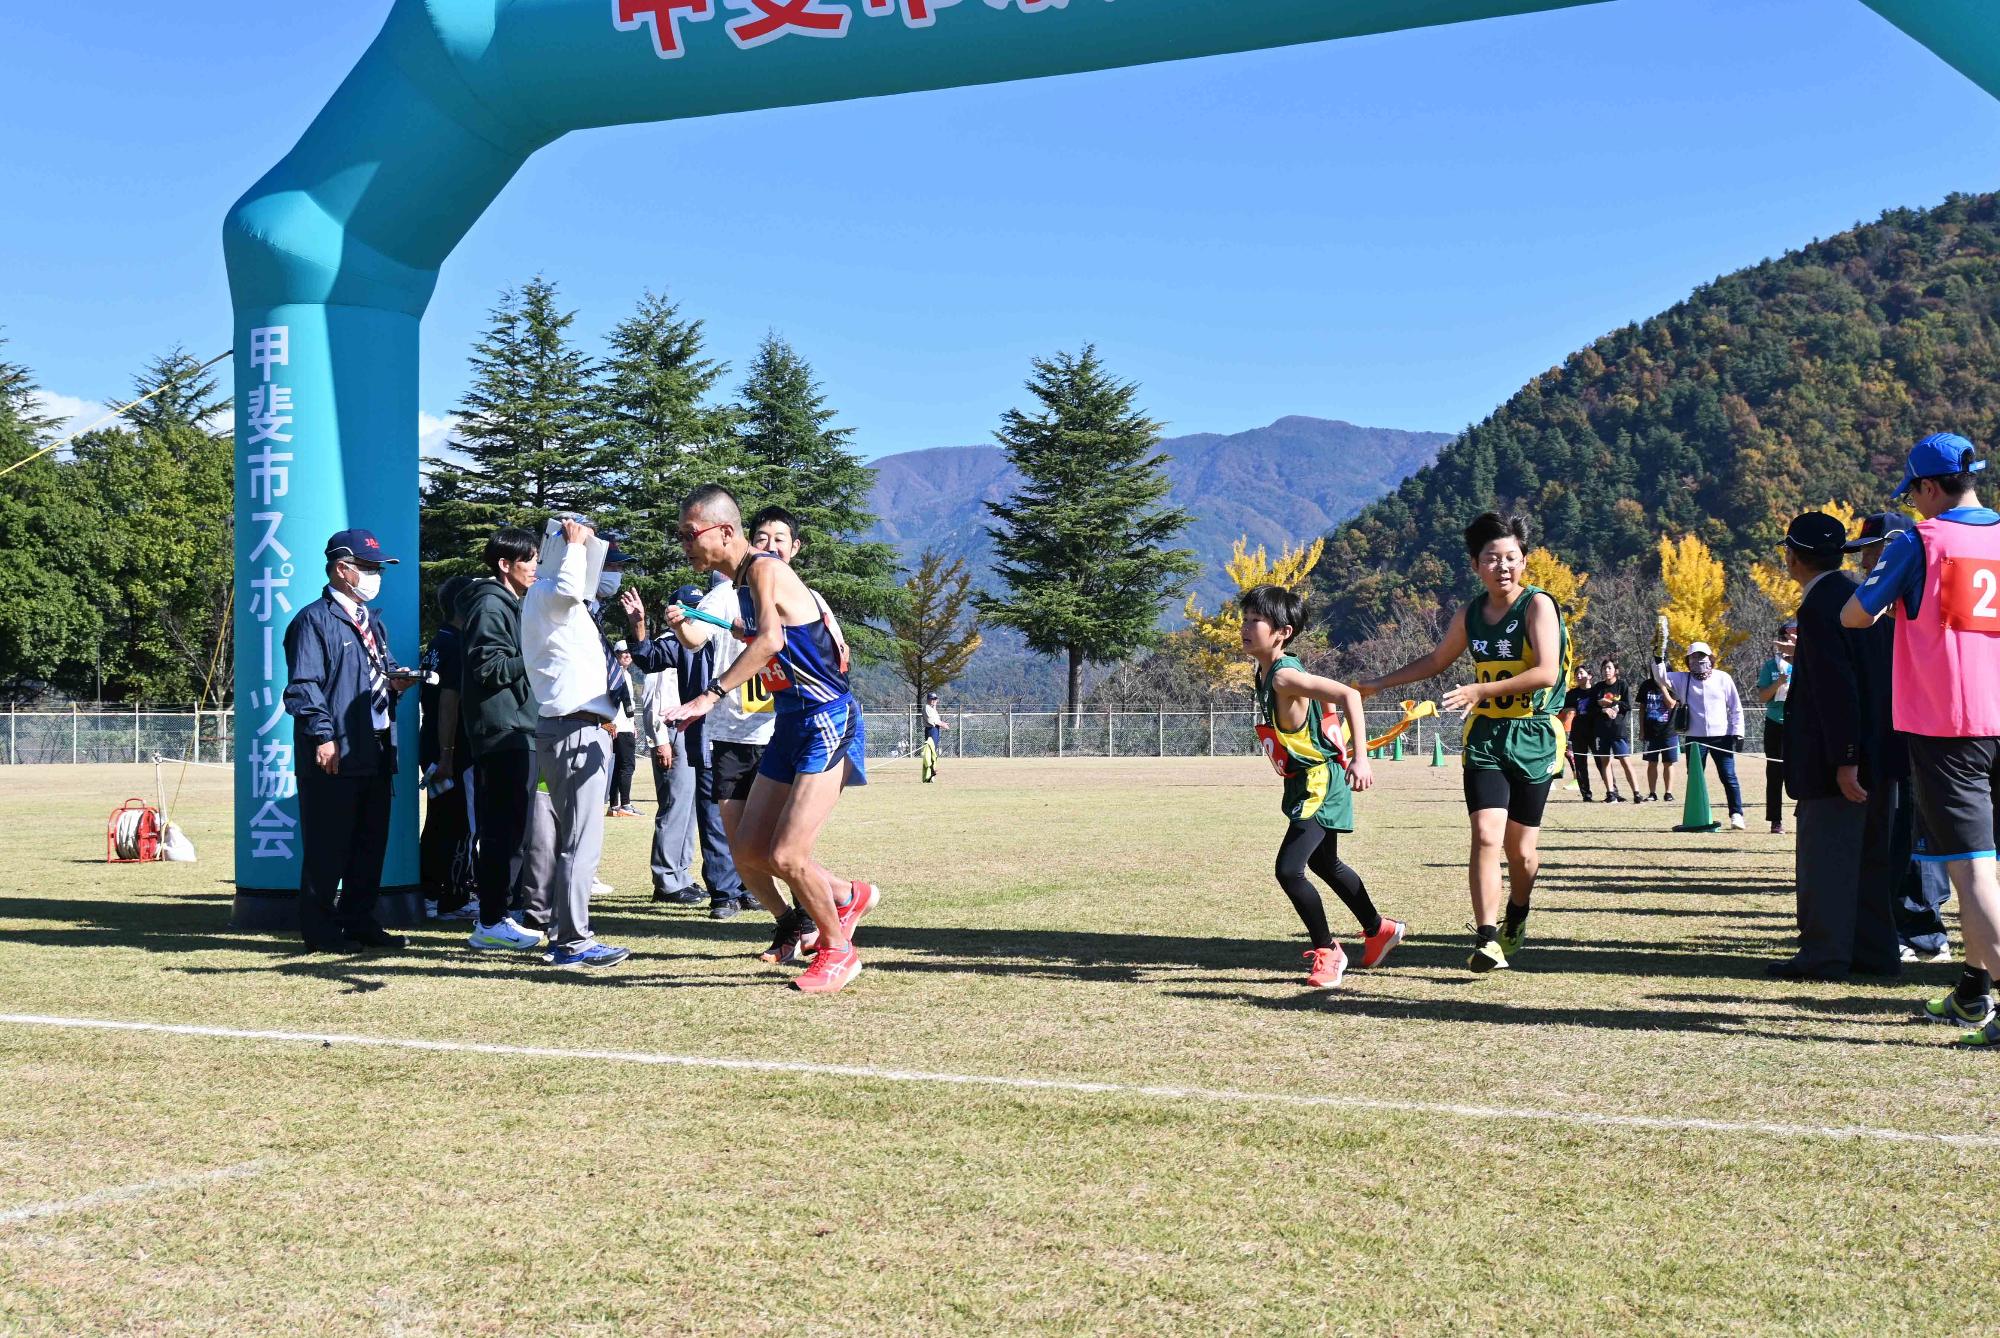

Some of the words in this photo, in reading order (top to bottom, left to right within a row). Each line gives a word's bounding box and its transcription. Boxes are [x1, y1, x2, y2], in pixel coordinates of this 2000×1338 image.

[247, 325, 298, 860] 甲斐市スポーツ協会
[1972, 568, 1997, 618] 2
[1471, 639, 1515, 659] 双葉
